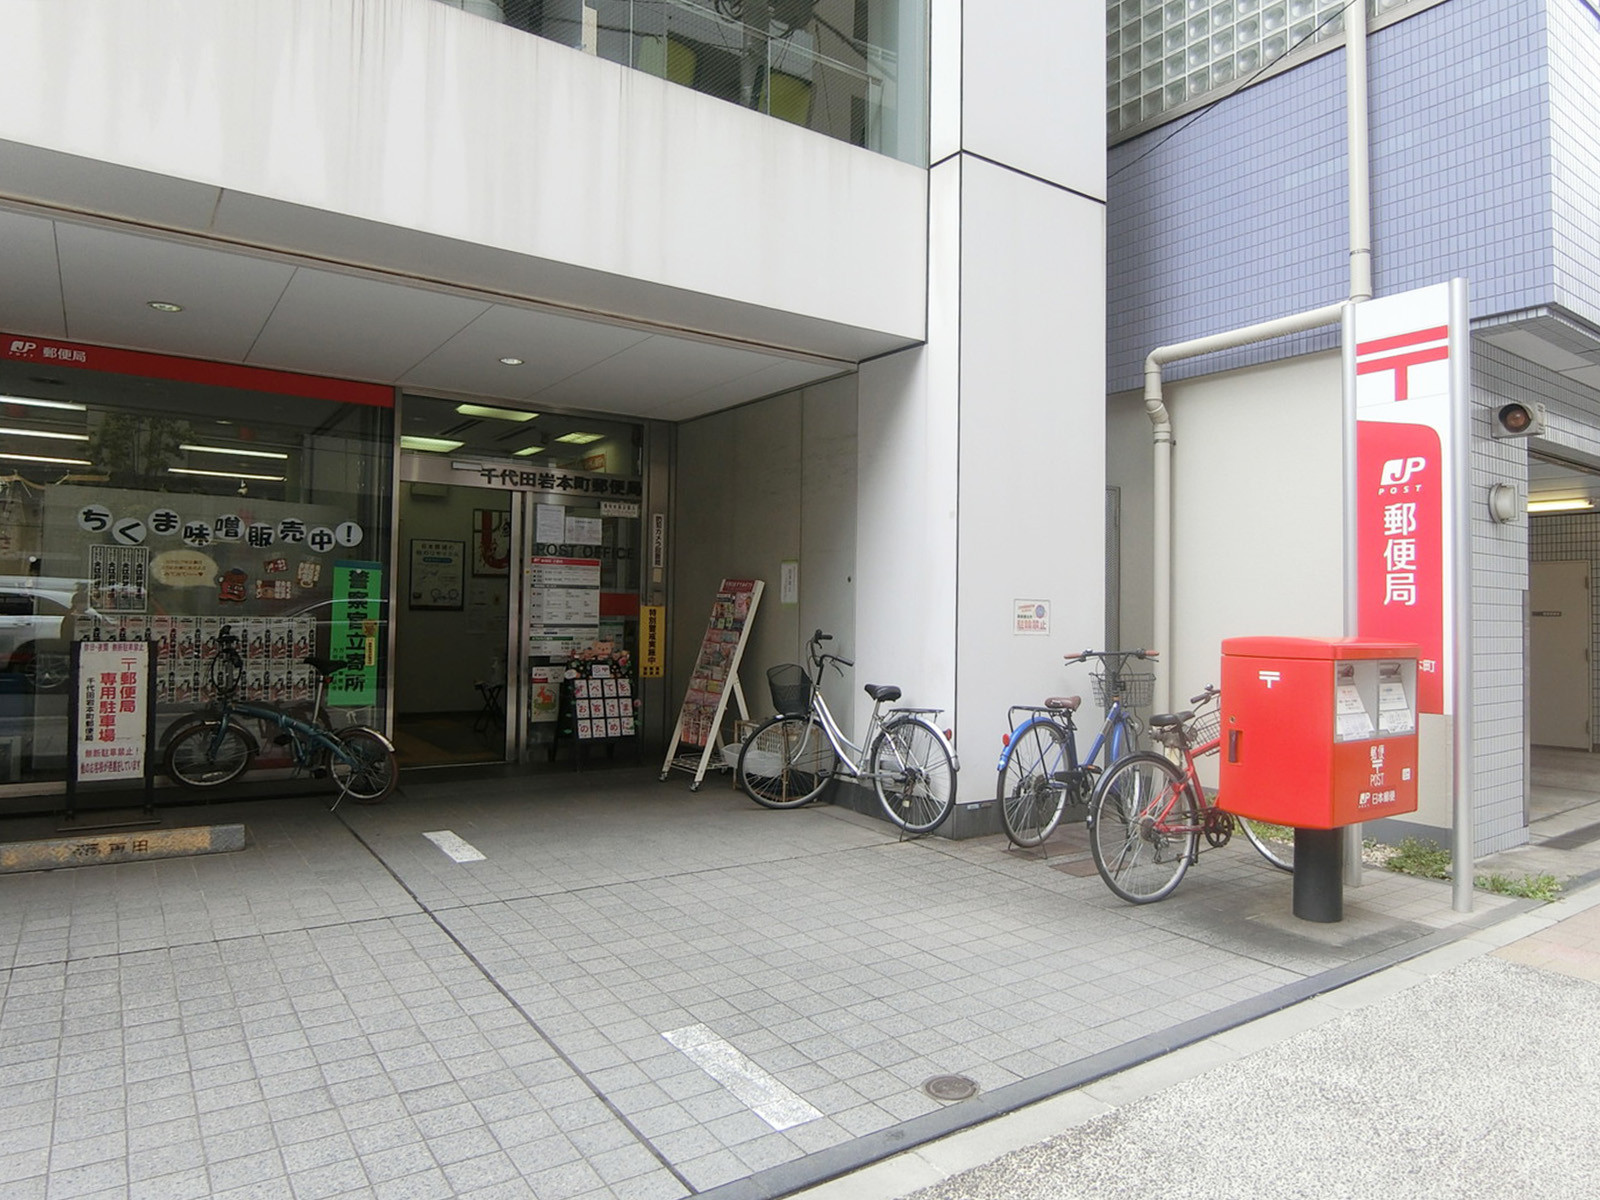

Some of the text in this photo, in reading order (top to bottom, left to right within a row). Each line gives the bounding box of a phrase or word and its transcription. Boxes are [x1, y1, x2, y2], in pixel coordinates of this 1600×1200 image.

[42, 347, 87, 363] 郵便局
[480, 468, 643, 497] 千代田岩本町郵便局
[1380, 456, 1427, 486] JP
[1377, 485, 1424, 496] POST
[537, 543, 634, 560] POST OFFICE
[1383, 502, 1417, 606] 郵便局
[344, 569, 370, 693] 警察官立寄所
[119, 671, 137, 714] 郵便局
[84, 677, 95, 742] 千代田岩本町郵便局
[98, 672, 118, 743] 専用駐車場
[1370, 744, 1385, 761] 郵便
[1370, 772, 1385, 787] POST
[1371, 790, 1396, 805] 日本郵便
